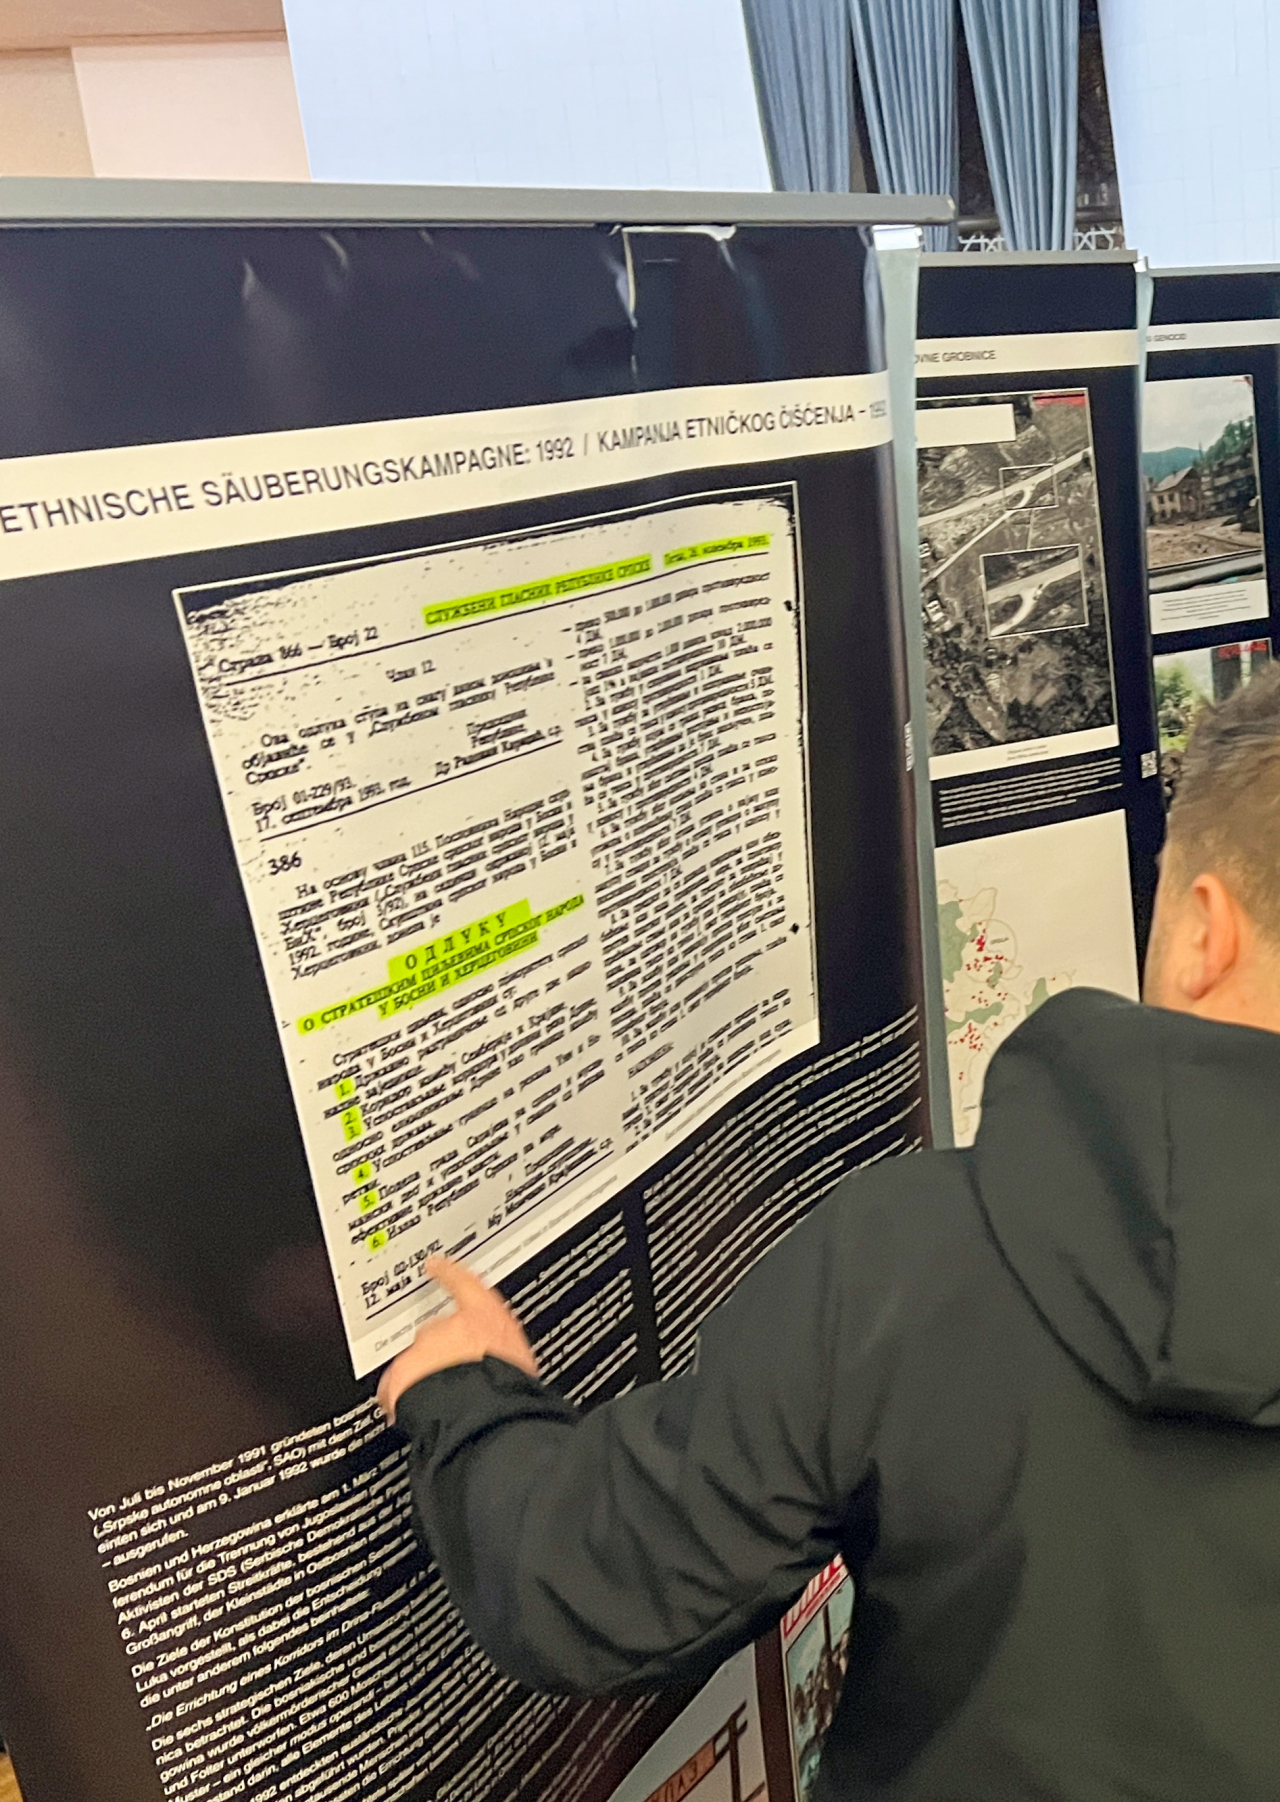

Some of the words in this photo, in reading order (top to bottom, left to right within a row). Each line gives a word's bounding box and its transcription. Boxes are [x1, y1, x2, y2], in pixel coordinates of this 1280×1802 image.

[1, 484, 195, 533] ETHNISCHE
[200, 441, 530, 506] SÄUBERUNGSKAMPAGNE:
[535, 436, 573, 464] 1992
[597, 421, 682, 452] KAMPANJA
[685, 407, 776, 439] ETNIČKOG
[779, 401, 855, 430] ČIŠĆENJA
[268, 852, 302, 876] 386
[361, 1271, 389, 1296] Број
[88, 1504, 116, 1521] Von
[119, 1491, 142, 1510] Juli
[144, 1485, 166, 1500] bis
[168, 1459, 235, 1491] November
[238, 1445, 266, 1463] 1991
[270, 1422, 332, 1455] gründeten
[97, 1530, 139, 1554] einten
[140, 1519, 167, 1537] sich
[169, 1506, 195, 1525] und
[196, 1499, 218, 1514] am
[218, 1493, 232, 1505] 9.
[233, 1475, 276, 1499] Januar
[279, 1461, 309, 1481] 1992
[309, 1447, 347, 1469] wurde
[151, 1480, 222, 1515] autonomne
[308, 1438, 327, 1454] mit
[328, 1428, 353, 1445] dem
[108, 1563, 162, 1593] Bosnien
[164, 1550, 190, 1570] und
[190, 1518, 273, 1559] Herzegowina
[274, 1499, 319, 1524] erklärte
[112, 1576, 175, 1609] ferendum
[176, 1566, 194, 1582] für
[196, 1558, 216, 1574] die
[217, 1533, 276, 1564] Trennung
[277, 1523, 300, 1539] von
[113, 1529, 189, 1566] ausgerufen.
[118, 1591, 180, 1625] Aktivisten
[183, 1580, 204, 1597] der
[207, 1565, 237, 1586] SDS
[240, 1538, 304, 1574] (Serbische
[121, 1627, 135, 1640] 6.
[138, 1612, 168, 1634] April
[170, 1589, 226, 1620] starteten
[125, 1614, 201, 1655] Großangriff,
[203, 1605, 224, 1622] der
[225, 1575, 293, 1612] Kleinstädte
[293, 1570, 306, 1581] in
[131, 1661, 155, 1678] Die
[156, 1646, 189, 1668] Ziele
[190, 1635, 212, 1652] der
[213, 1603, 283, 1642] Konstitution
[285, 1592, 305, 1608] der
[135, 1672, 169, 1693] Luka
[169, 1642, 237, 1678] vorgestellt,
[238, 1632, 257, 1647] als
[258, 1613, 291, 1637] dabei
[292, 1605, 311, 1621] die
[140, 1692, 161, 1709] die
[162, 1676, 195, 1698] unter
[197, 1651, 251, 1683] anderem
[252, 1622, 310, 1657] folgendes
[175, 1680, 239, 1717] Errichtung
[239, 1664, 272, 1686] eines
[274, 1636, 324, 1670] Korridors
[325, 1628, 340, 1642] im
[151, 1735, 175, 1751] Die
[176, 1716, 214, 1740] sechs
[214, 1676, 292, 1722] strategischen
[155, 1748, 183, 1766] nica
[251, 1703, 273, 1720] Die
[164, 1775, 189, 1796] und
[190, 1759, 225, 1784] Folter
[227, 1723, 298, 1766] unterworfen.
[299, 1704, 327, 1725] Etwa
[328, 1690, 350, 1709] 600
[223, 1768, 242, 1784] ein
[243, 1741, 288, 1775] gleicher
[290, 1719, 327, 1747] modus
[302, 1720, 353, 1755] Elemente
[160, 1754, 206, 1784] gowina
[206, 1733, 245, 1758] wurde
